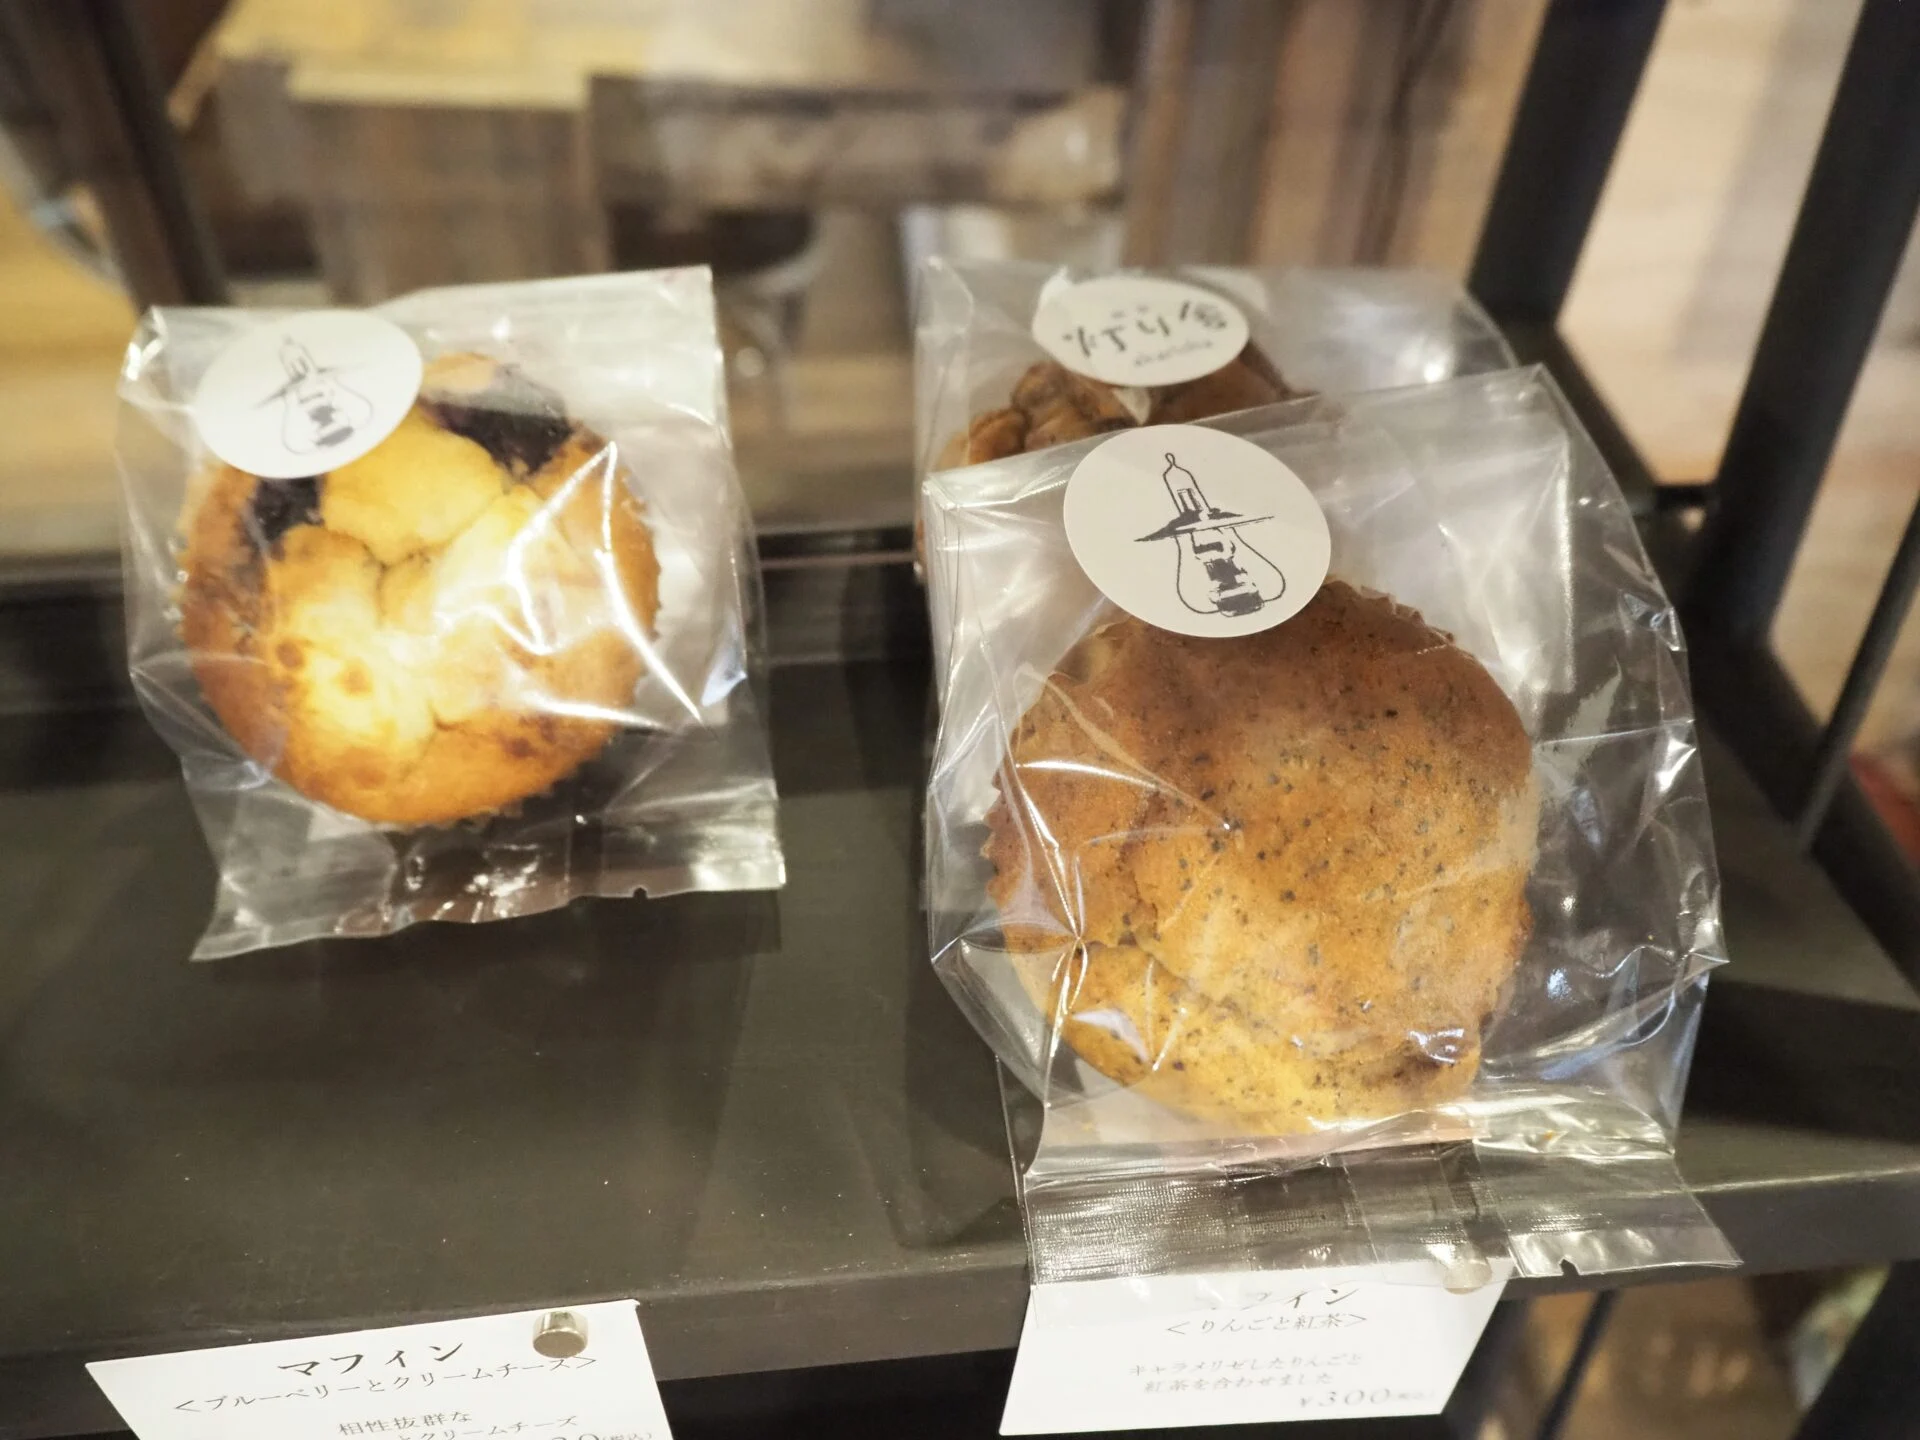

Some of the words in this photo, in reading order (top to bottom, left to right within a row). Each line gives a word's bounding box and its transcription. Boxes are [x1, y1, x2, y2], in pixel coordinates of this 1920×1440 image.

[278, 1341, 464, 1377] マフィン
[339, 1410, 473, 1438] 相性抜群な
